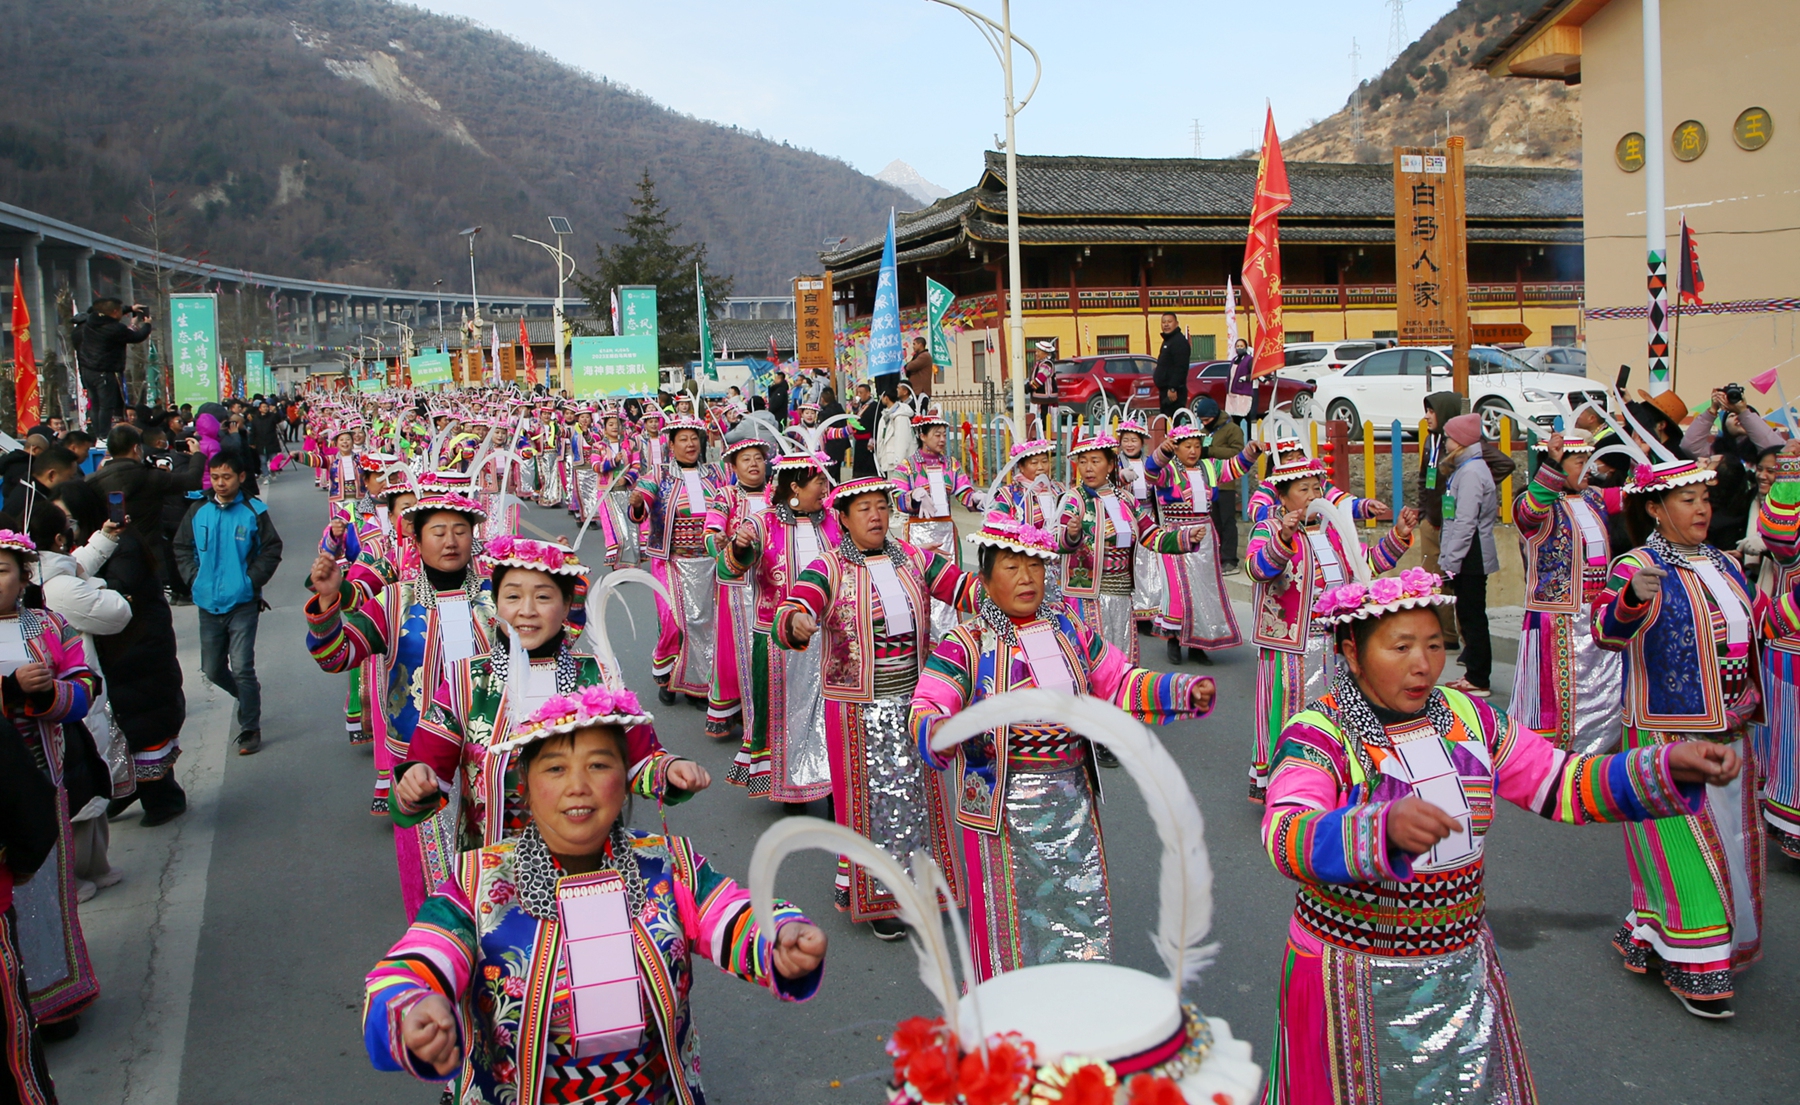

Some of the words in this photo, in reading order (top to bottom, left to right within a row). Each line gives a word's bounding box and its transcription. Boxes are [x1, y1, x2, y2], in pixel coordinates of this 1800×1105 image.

[1625, 113, 1765, 164] 生态王
[1411, 181, 1440, 308] 白马人家
[176, 313, 194, 378] 生态王朗
[626, 302, 639, 336] 生态
[803, 293, 820, 352] 白马藏家园
[193, 330, 211, 387] 风情白马
[583, 364, 647, 376] 海神舞表演队
